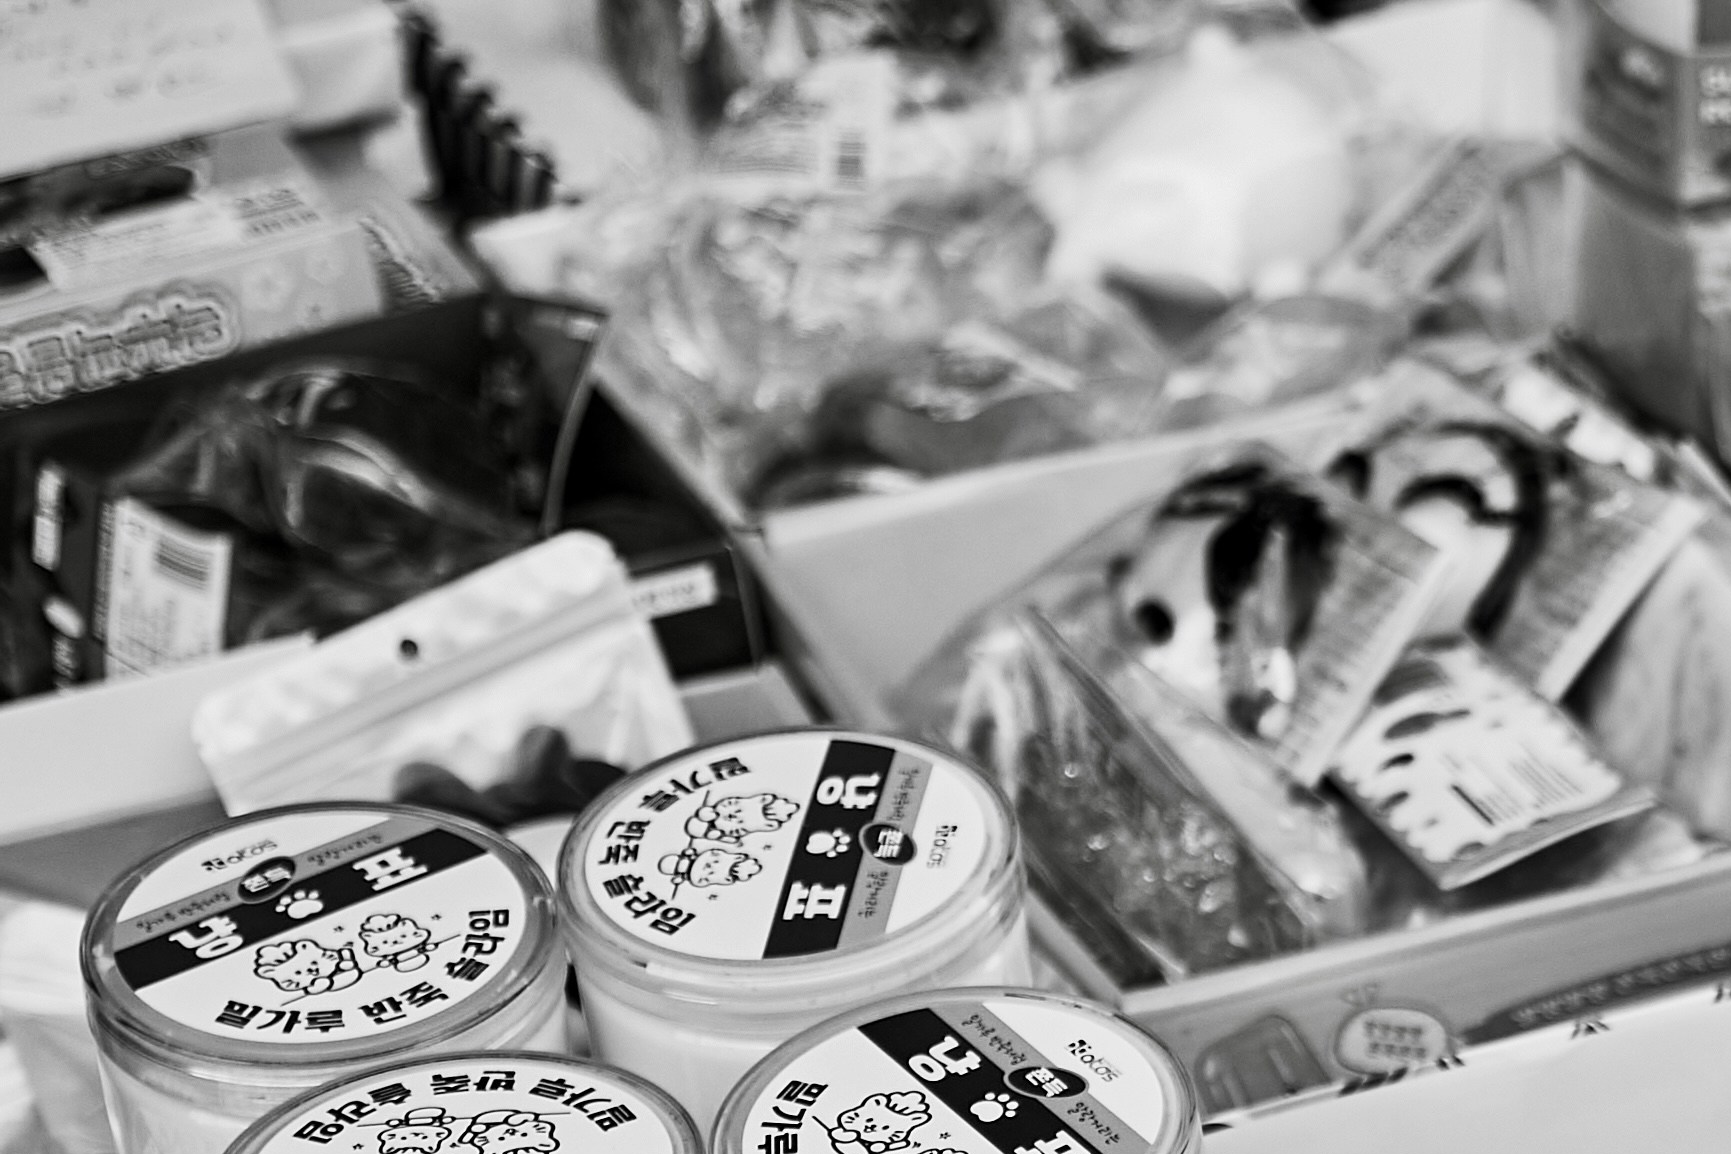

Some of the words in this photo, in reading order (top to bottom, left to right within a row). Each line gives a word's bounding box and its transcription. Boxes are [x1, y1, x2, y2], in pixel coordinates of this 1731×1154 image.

[639, 756, 752, 814] 밀가루
[816, 774, 880, 812] 냥
[598, 817, 652, 866] 반죽
[167, 916, 245, 960] 냥
[351, 848, 429, 893] 표
[604, 872, 697, 936] 슬라임
[782, 880, 846, 921] 표
[213, 1000, 345, 1035] 밀가루
[358, 981, 450, 1025] 반죽
[444, 908, 510, 981] 슬라임
[429, 1069, 517, 1098] 반죽
[908, 1035, 982, 1083] 냥
[1025, 1066, 1068, 1098] 쫀득
[293, 1082, 413, 1145] 슬라임
[527, 1075, 638, 1134] 밀가루
